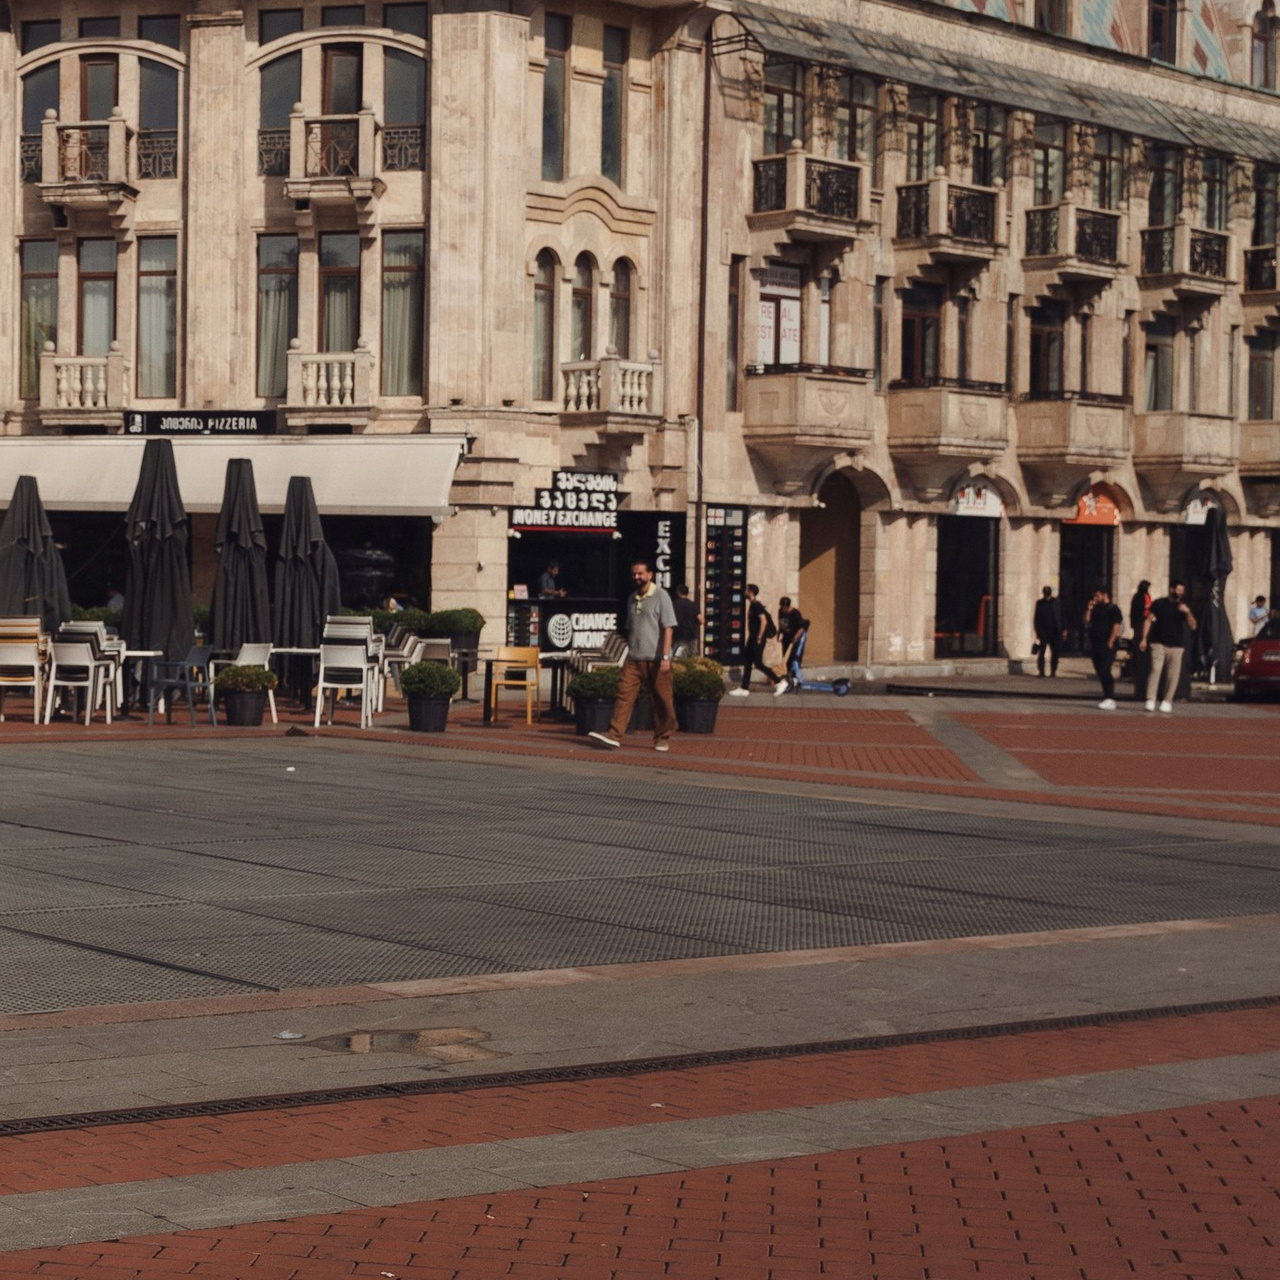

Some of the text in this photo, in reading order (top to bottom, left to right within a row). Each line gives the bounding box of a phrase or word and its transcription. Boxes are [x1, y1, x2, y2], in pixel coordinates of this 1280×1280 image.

[160, 417, 204, 430] პიცერია
[207, 417, 258, 430] PIZZERIA
[540, 490, 617, 510] გაცვლა
[512, 509, 617, 527] MONEY EXCHANGE
[656, 521, 671, 588] EXCH
[571, 613, 617, 630] CHANGE
[572, 631, 608, 649] MONE
